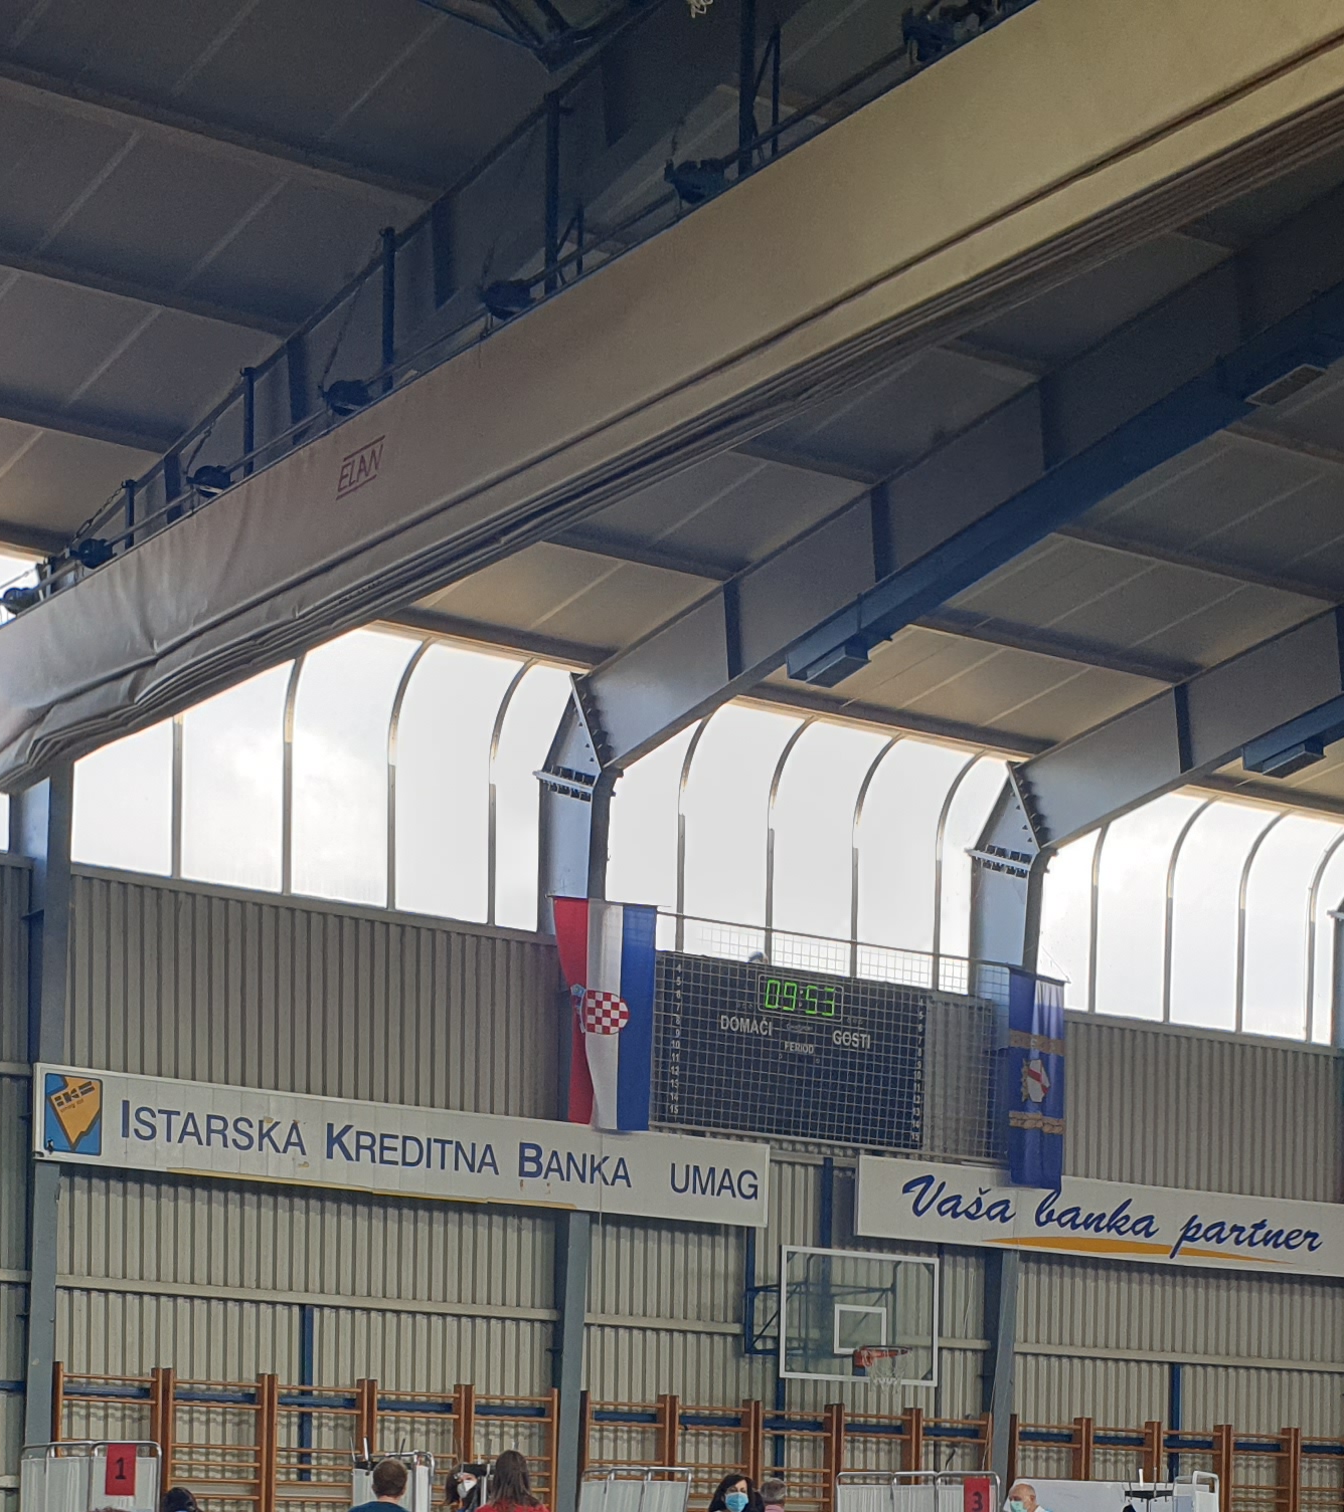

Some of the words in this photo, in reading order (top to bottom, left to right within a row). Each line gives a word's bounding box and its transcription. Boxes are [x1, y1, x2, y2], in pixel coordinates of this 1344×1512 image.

[338, 443, 384, 493] ELAN
[765, 979, 835, 1016] 09:53
[784, 1040, 815, 1055] PERIOD
[832, 1030, 871, 1050] GOSTI
[121, 1099, 306, 1156] ISTARSKA
[326, 1125, 500, 1177] KREDITNA
[519, 1142, 632, 1189] BANKA
[670, 1161, 760, 1202] UMAG
[901, 1174, 1016, 1224] Vaša
[1035, 1188, 1160, 1239] banka
[1168, 1216, 1323, 1260] partner
[114, 1456, 127, 1480] 1
[971, 1490, 984, 1512] 3
